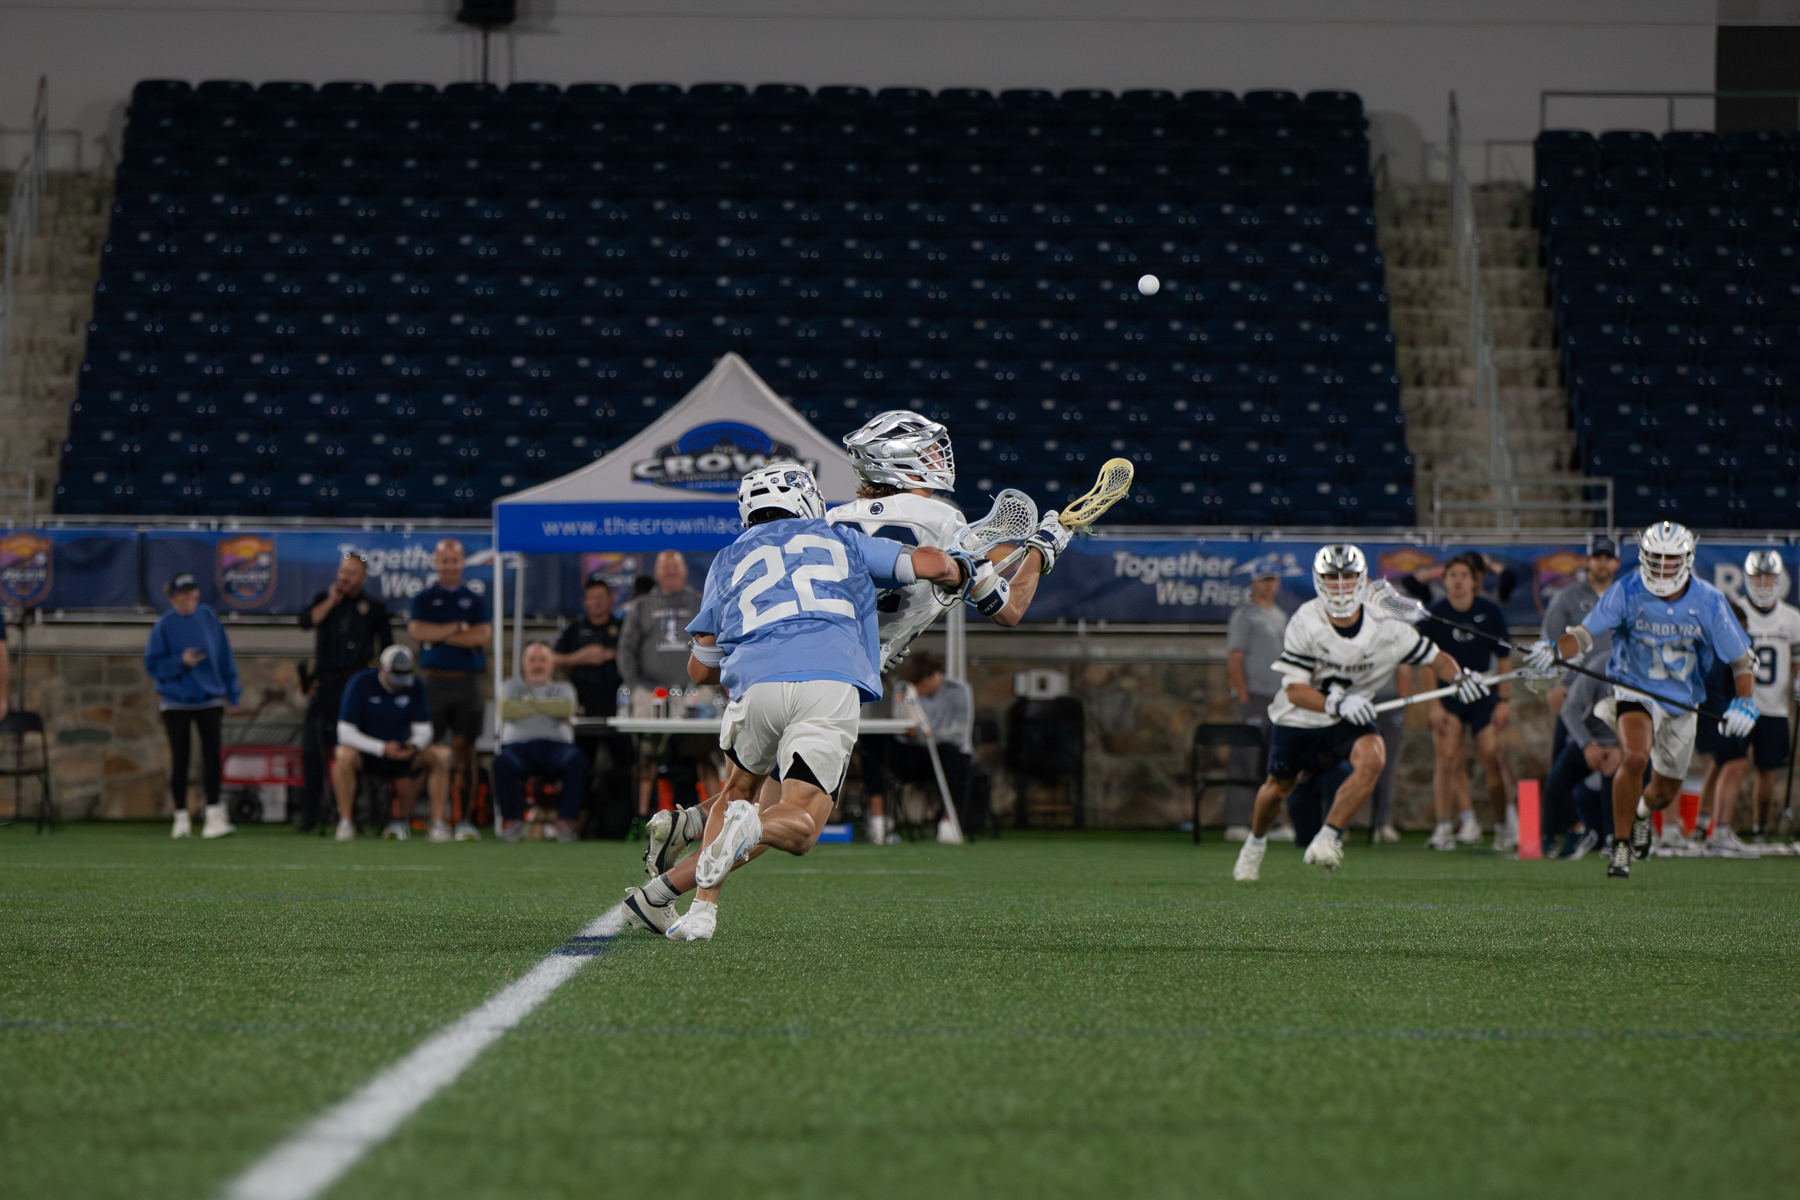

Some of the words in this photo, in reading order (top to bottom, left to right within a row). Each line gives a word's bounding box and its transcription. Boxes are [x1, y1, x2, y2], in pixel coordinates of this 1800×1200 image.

[632, 452, 818, 479] CROW
[1113, 551, 1236, 585] Together
[732, 534, 856, 635] 22
[1156, 579, 1200, 606] We
[1635, 619, 1702, 637] CAROLINA
[1643, 637, 1697, 682] 15
